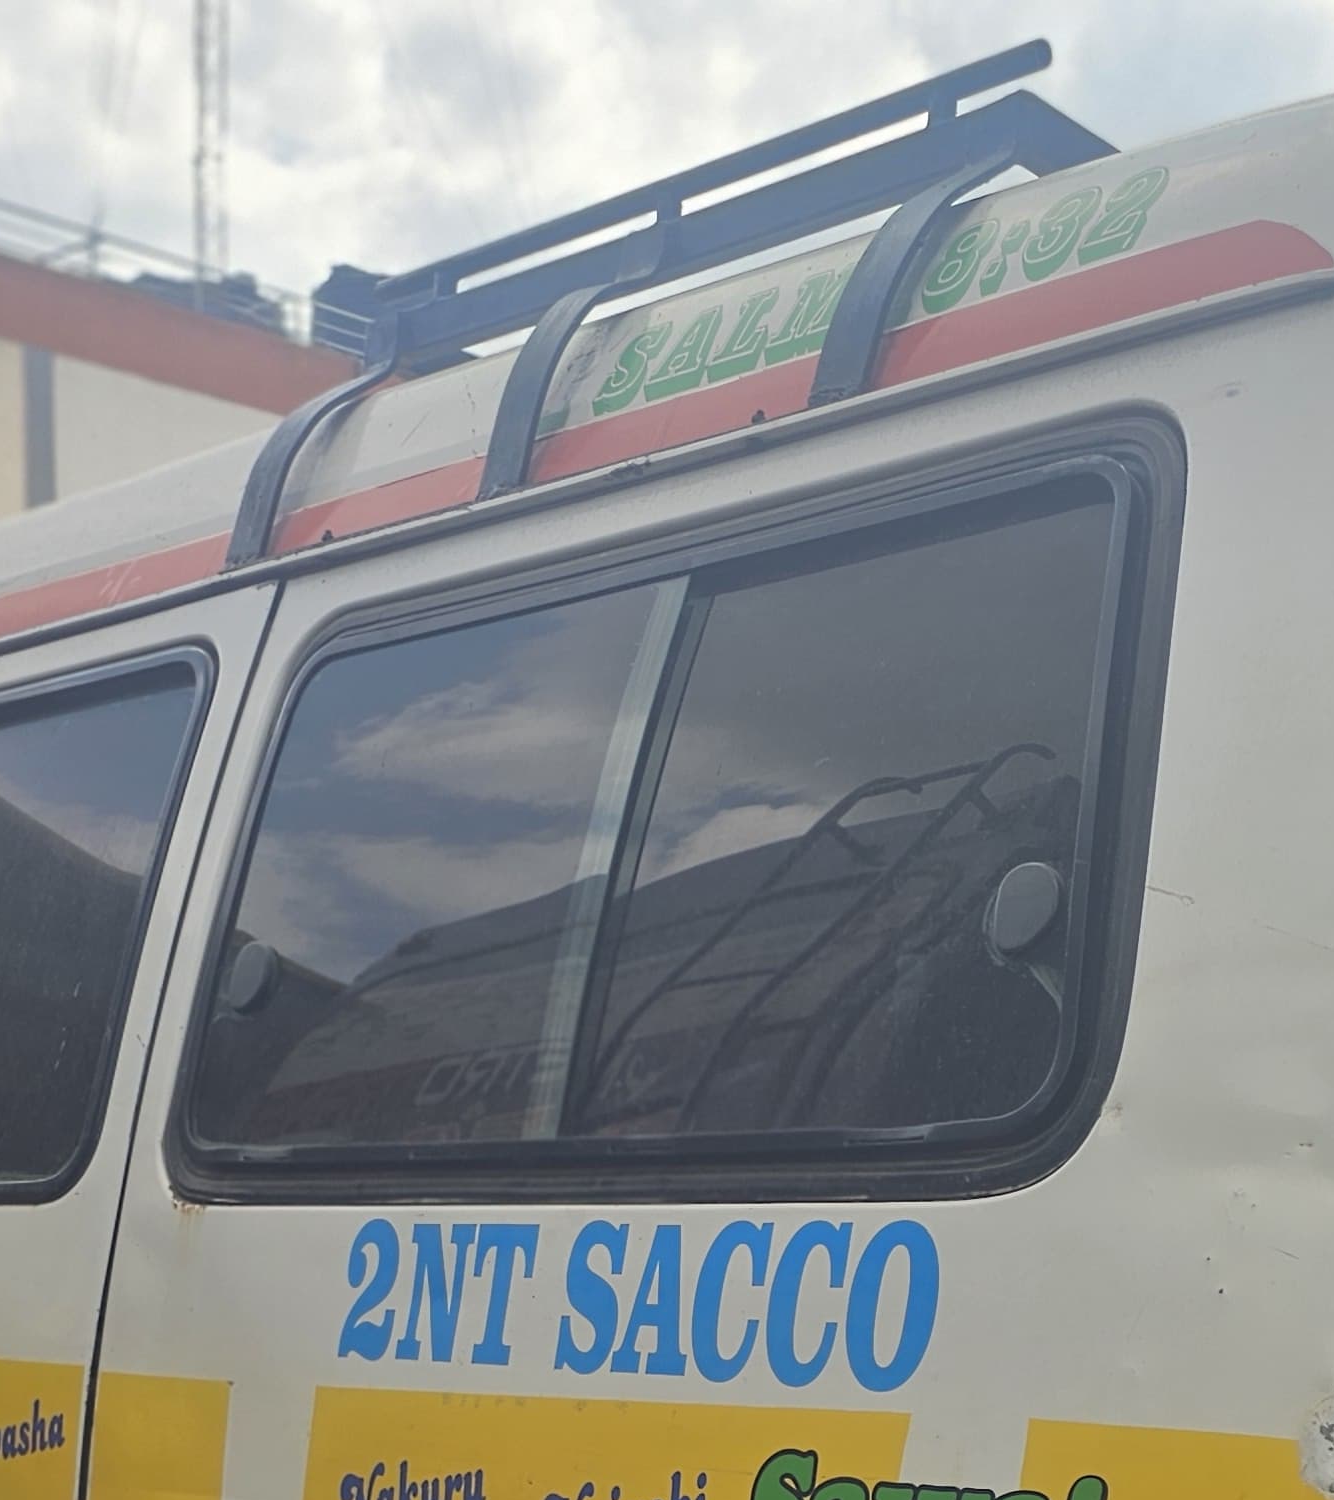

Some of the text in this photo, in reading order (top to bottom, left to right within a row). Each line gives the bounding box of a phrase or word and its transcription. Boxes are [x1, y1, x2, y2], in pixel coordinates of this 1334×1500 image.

[534, 167, 1169, 438] SALM 8:32
[338, 1218, 940, 1392] 2NT SACCO
